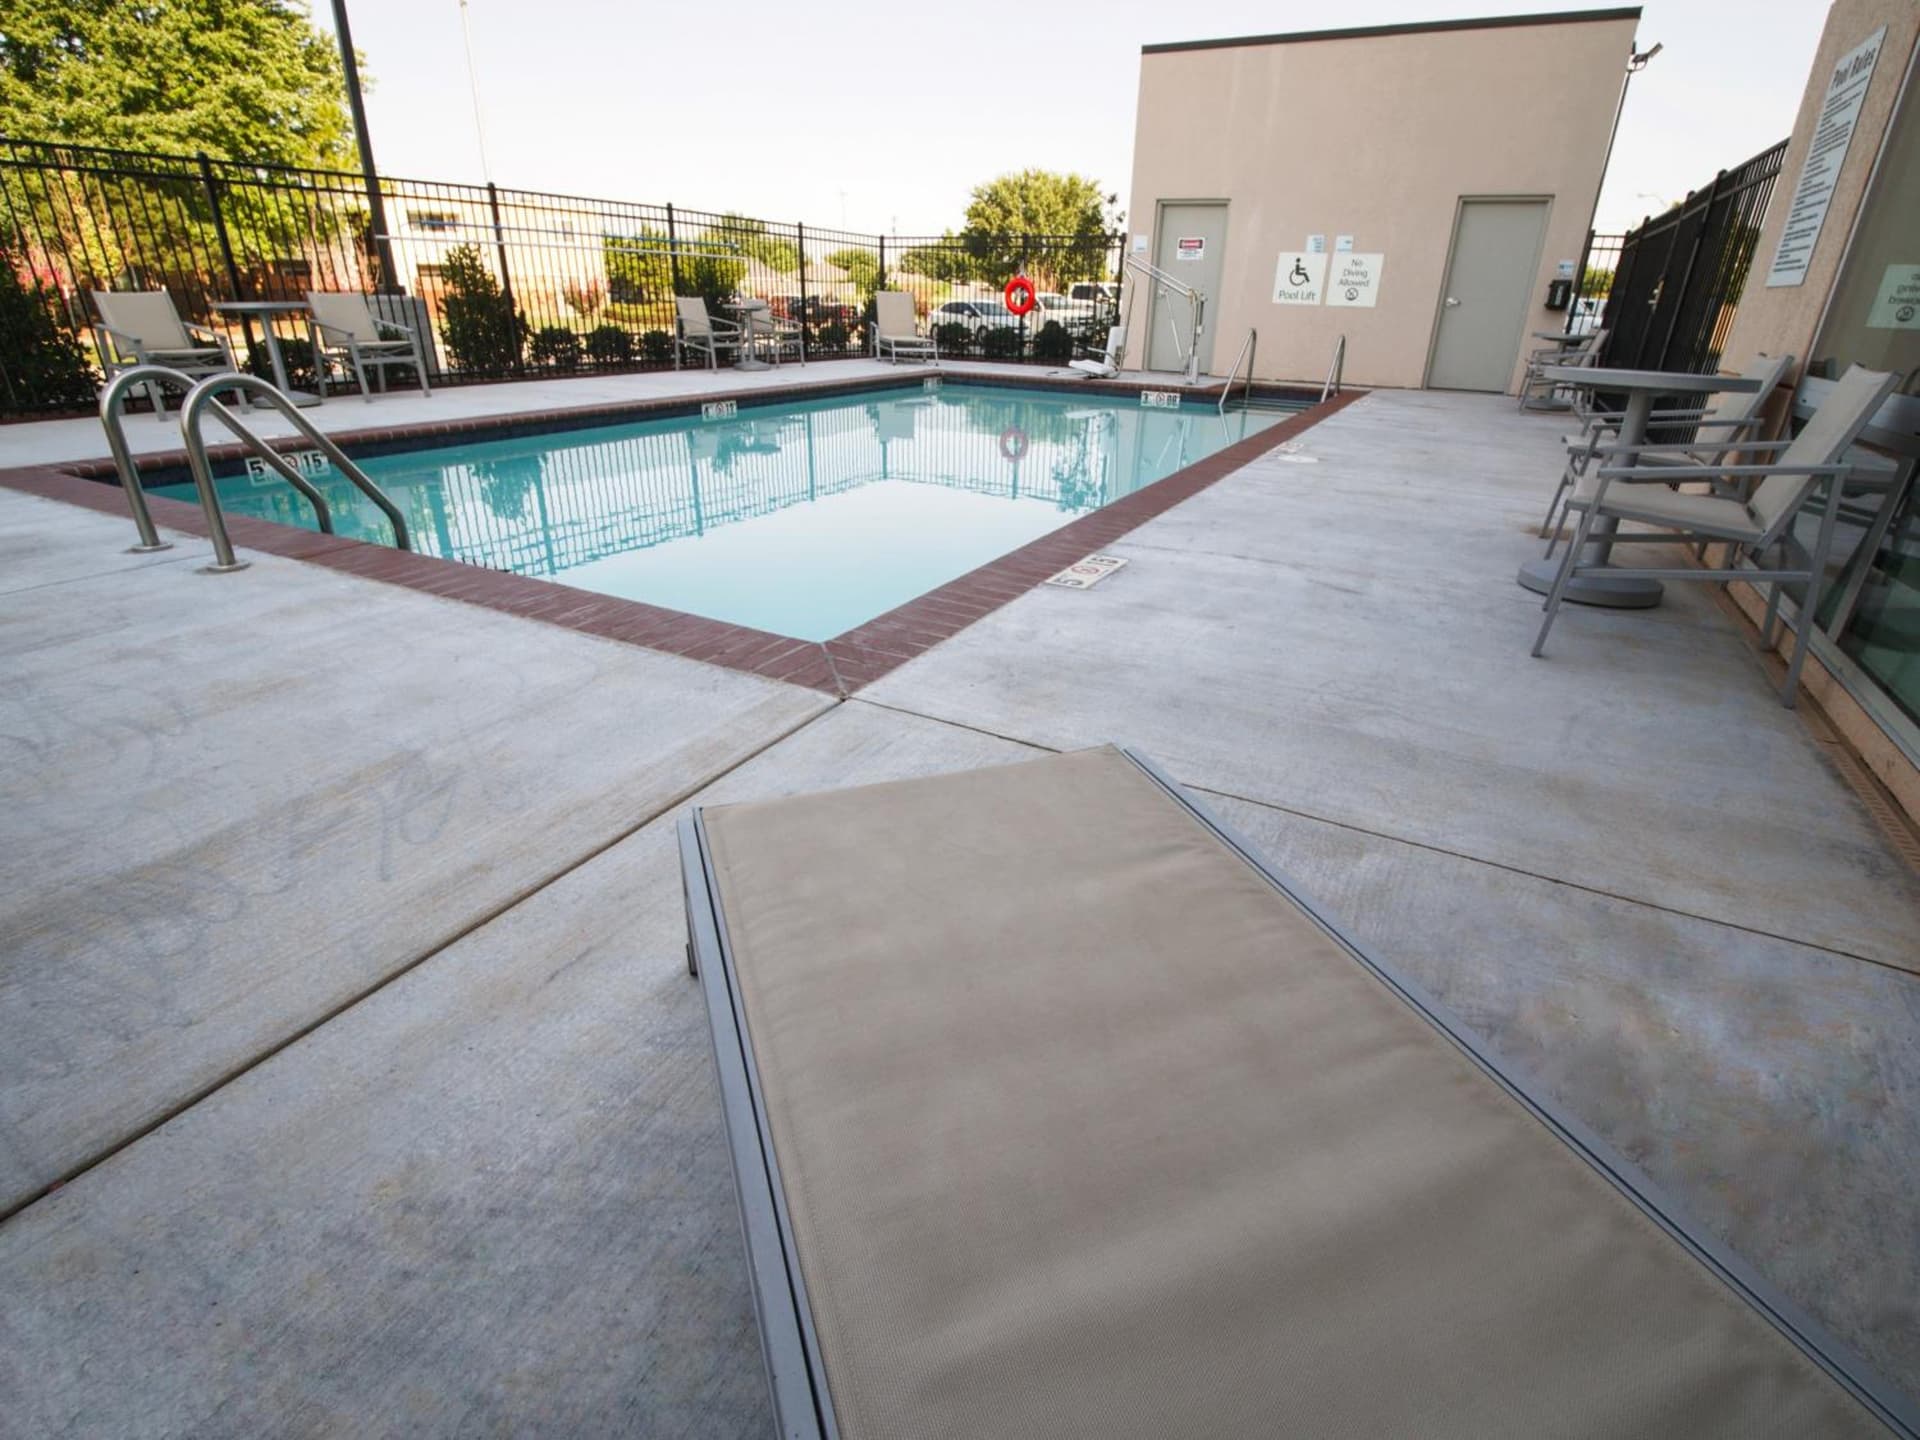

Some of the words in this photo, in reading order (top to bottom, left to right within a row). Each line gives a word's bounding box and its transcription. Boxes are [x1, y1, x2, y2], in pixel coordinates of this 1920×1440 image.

[1850, 47, 1877, 79] Rules
[1351, 258, 1364, 267] No
[1343, 268, 1369, 279] Diving
[1338, 279, 1370, 288] Allowed
[1278, 289, 1300, 300] Pool
[1300, 290, 1316, 301] Lift
[249, 460, 265, 484] 5
